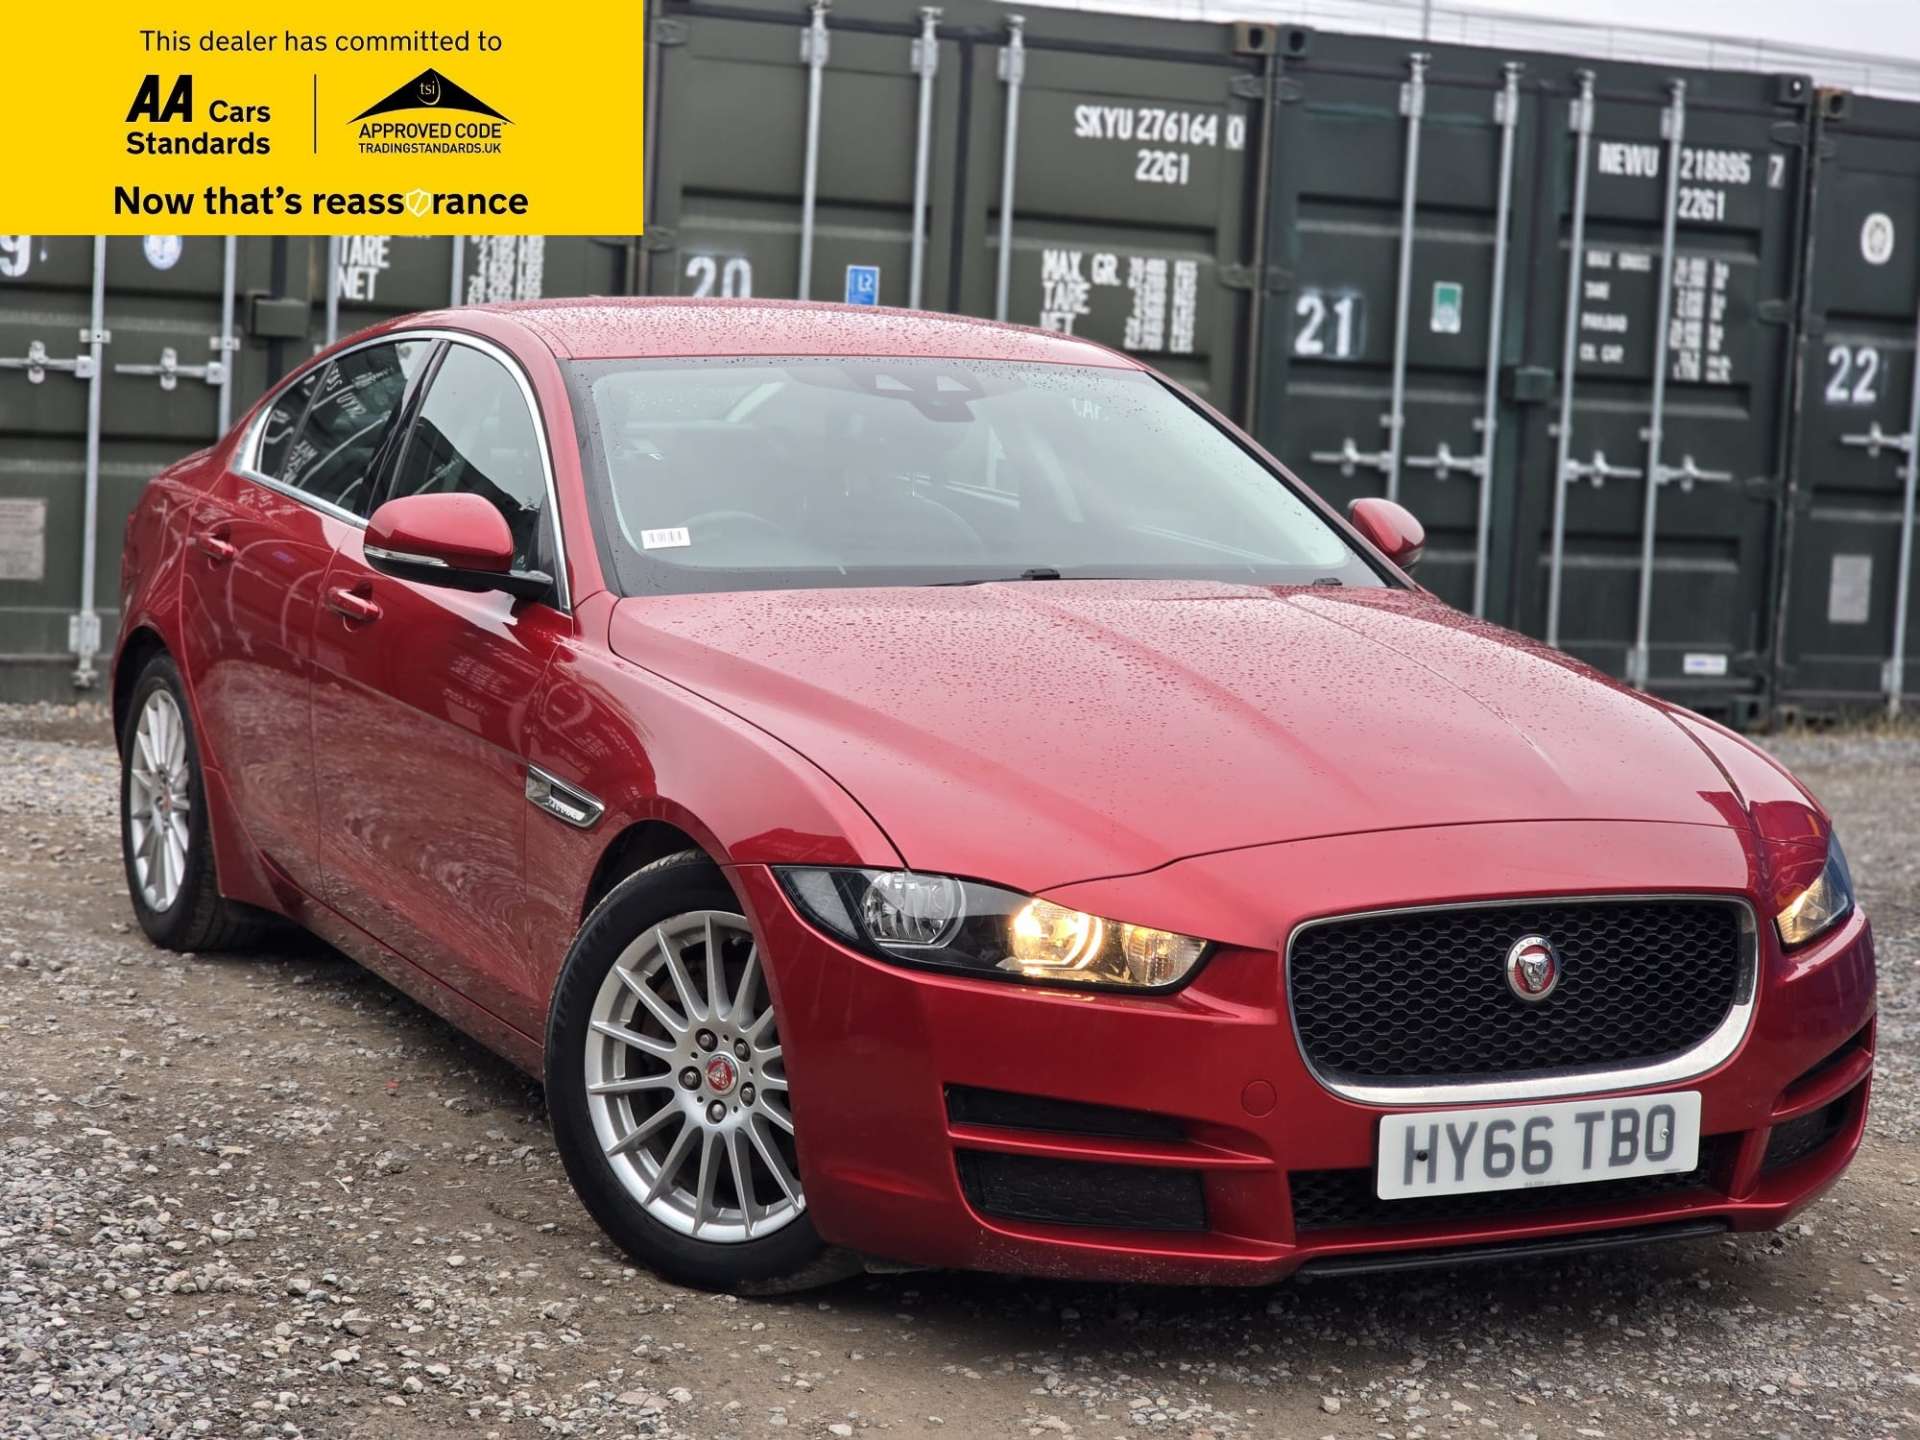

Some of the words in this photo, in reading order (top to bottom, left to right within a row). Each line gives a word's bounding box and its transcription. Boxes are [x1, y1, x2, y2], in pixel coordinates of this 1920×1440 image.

[1075, 104, 1133, 140] SKYU
[1136, 108, 1218, 146] 276164
[1598, 141, 1660, 177] NEWU
[1767, 154, 1786, 188] 7
[338, 267, 379, 301] NET
[685, 256, 752, 299] 20
[1295, 296, 1353, 357] 21
[1826, 345, 1879, 402] 22
[1403, 1115, 1555, 1186] HY66
[1574, 1103, 1676, 1170] TBO
